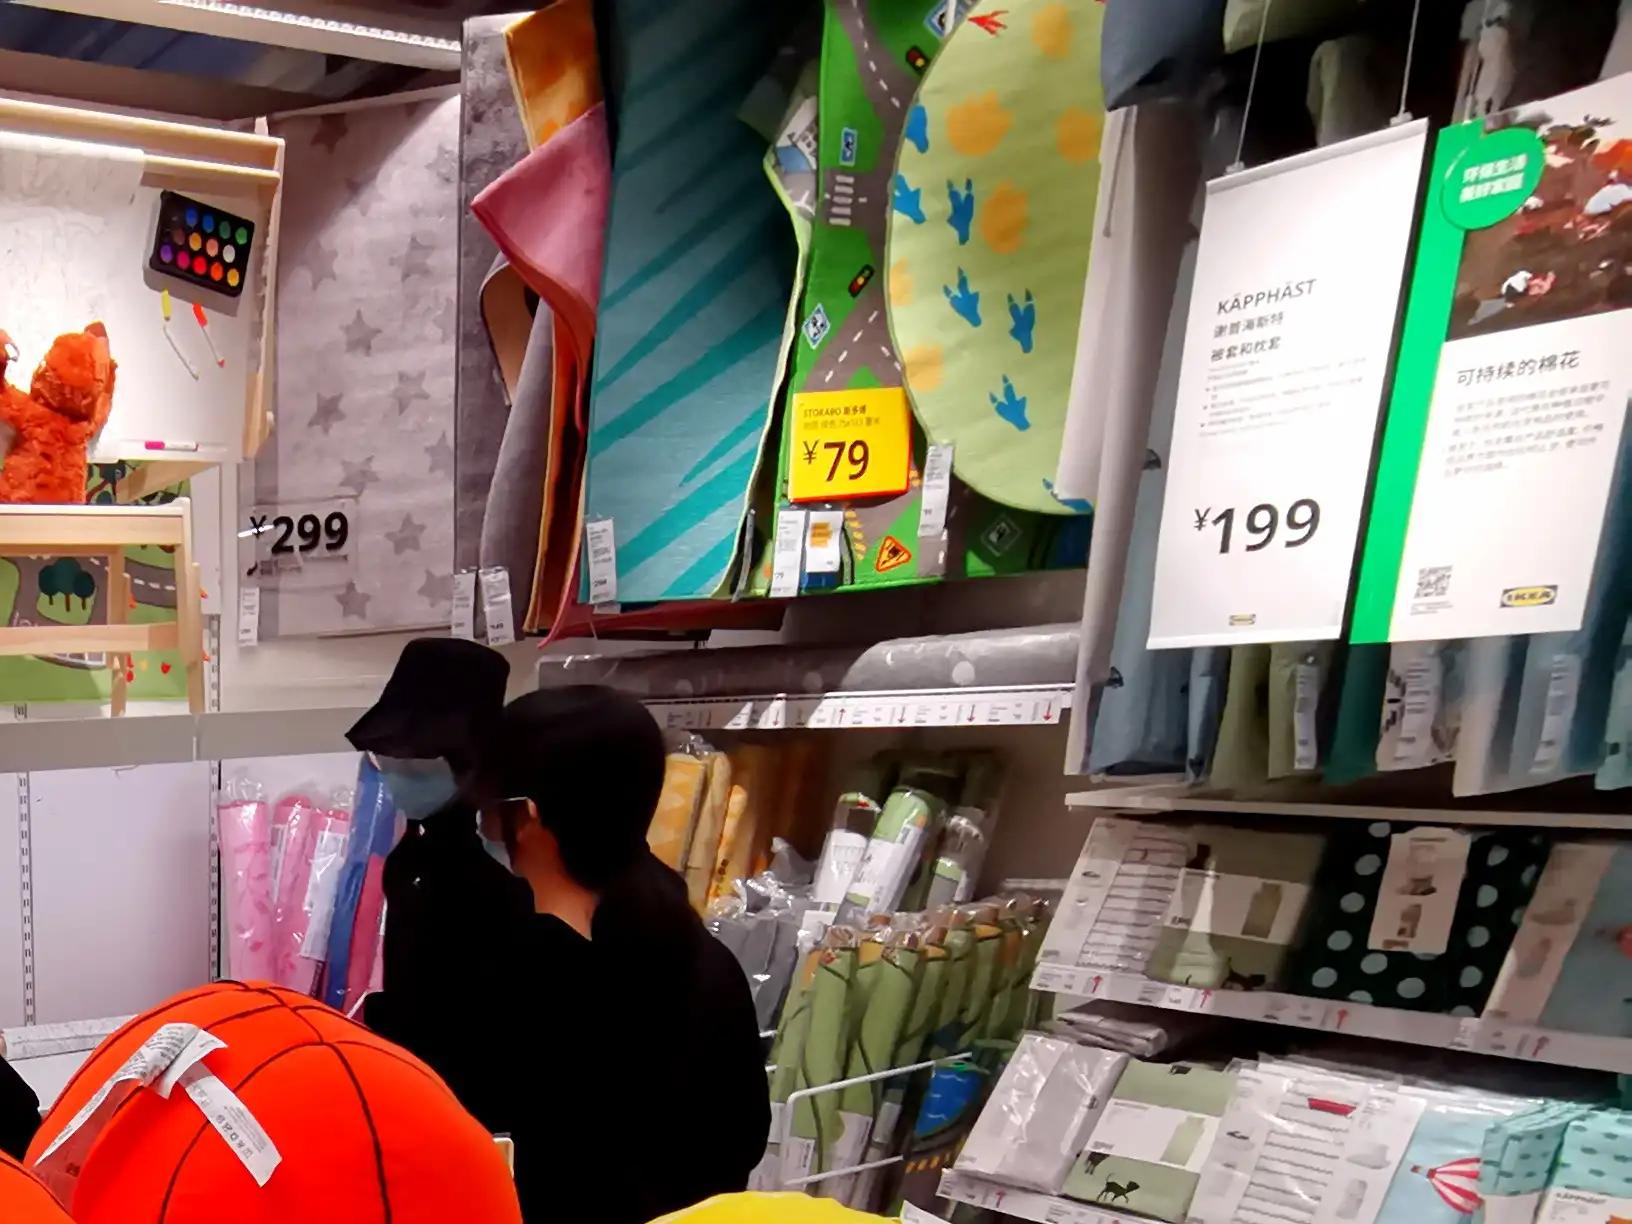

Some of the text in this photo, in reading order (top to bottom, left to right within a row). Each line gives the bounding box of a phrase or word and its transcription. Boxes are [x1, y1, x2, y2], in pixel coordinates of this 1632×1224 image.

[1217, 278, 1317, 316] KÄPPHÄST
[1456, 350, 1581, 386] 可持续的棉花
[802, 439, 869, 482] ¥79
[1193, 498, 1321, 554] ¥199
[1505, 589, 1554, 604] IKEA
